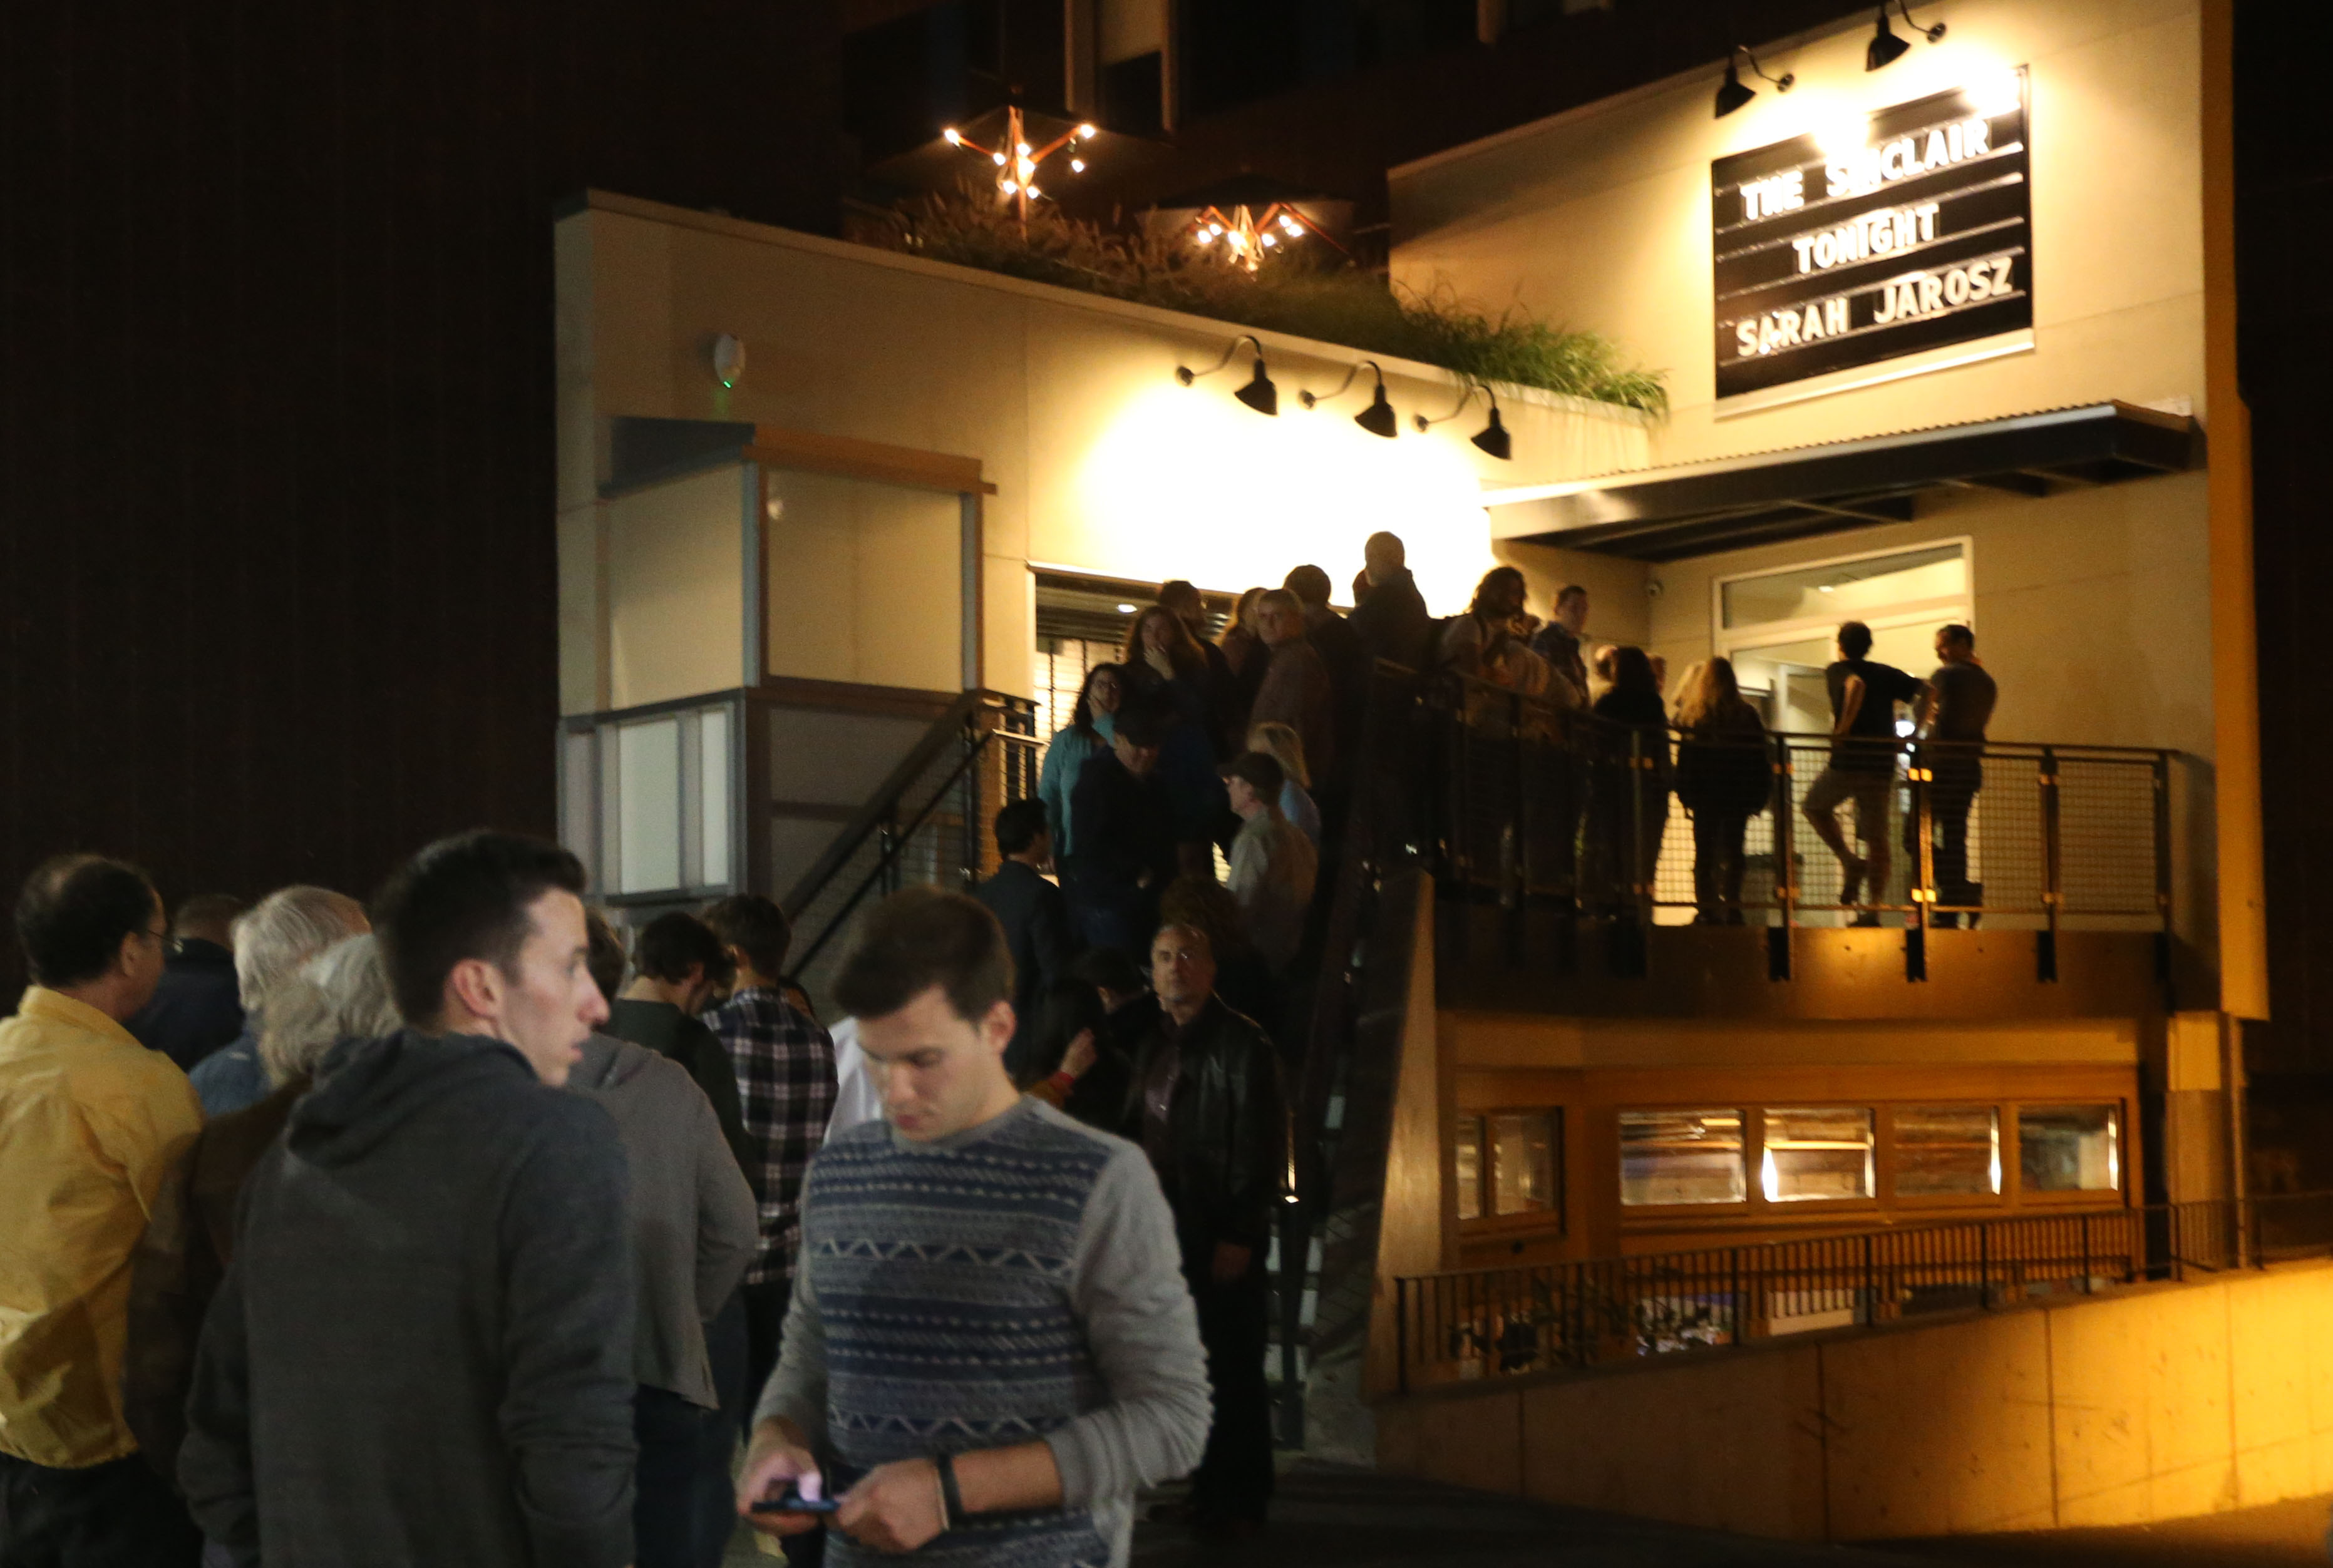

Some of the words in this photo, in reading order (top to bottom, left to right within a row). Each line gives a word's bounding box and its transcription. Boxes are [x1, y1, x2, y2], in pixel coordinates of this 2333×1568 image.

[1741, 170, 1803, 220] THE
[1793, 203, 1939, 274] TONIGHT
[1736, 297, 1848, 356] SARAH
[1874, 257, 2012, 324] JAROSZ
